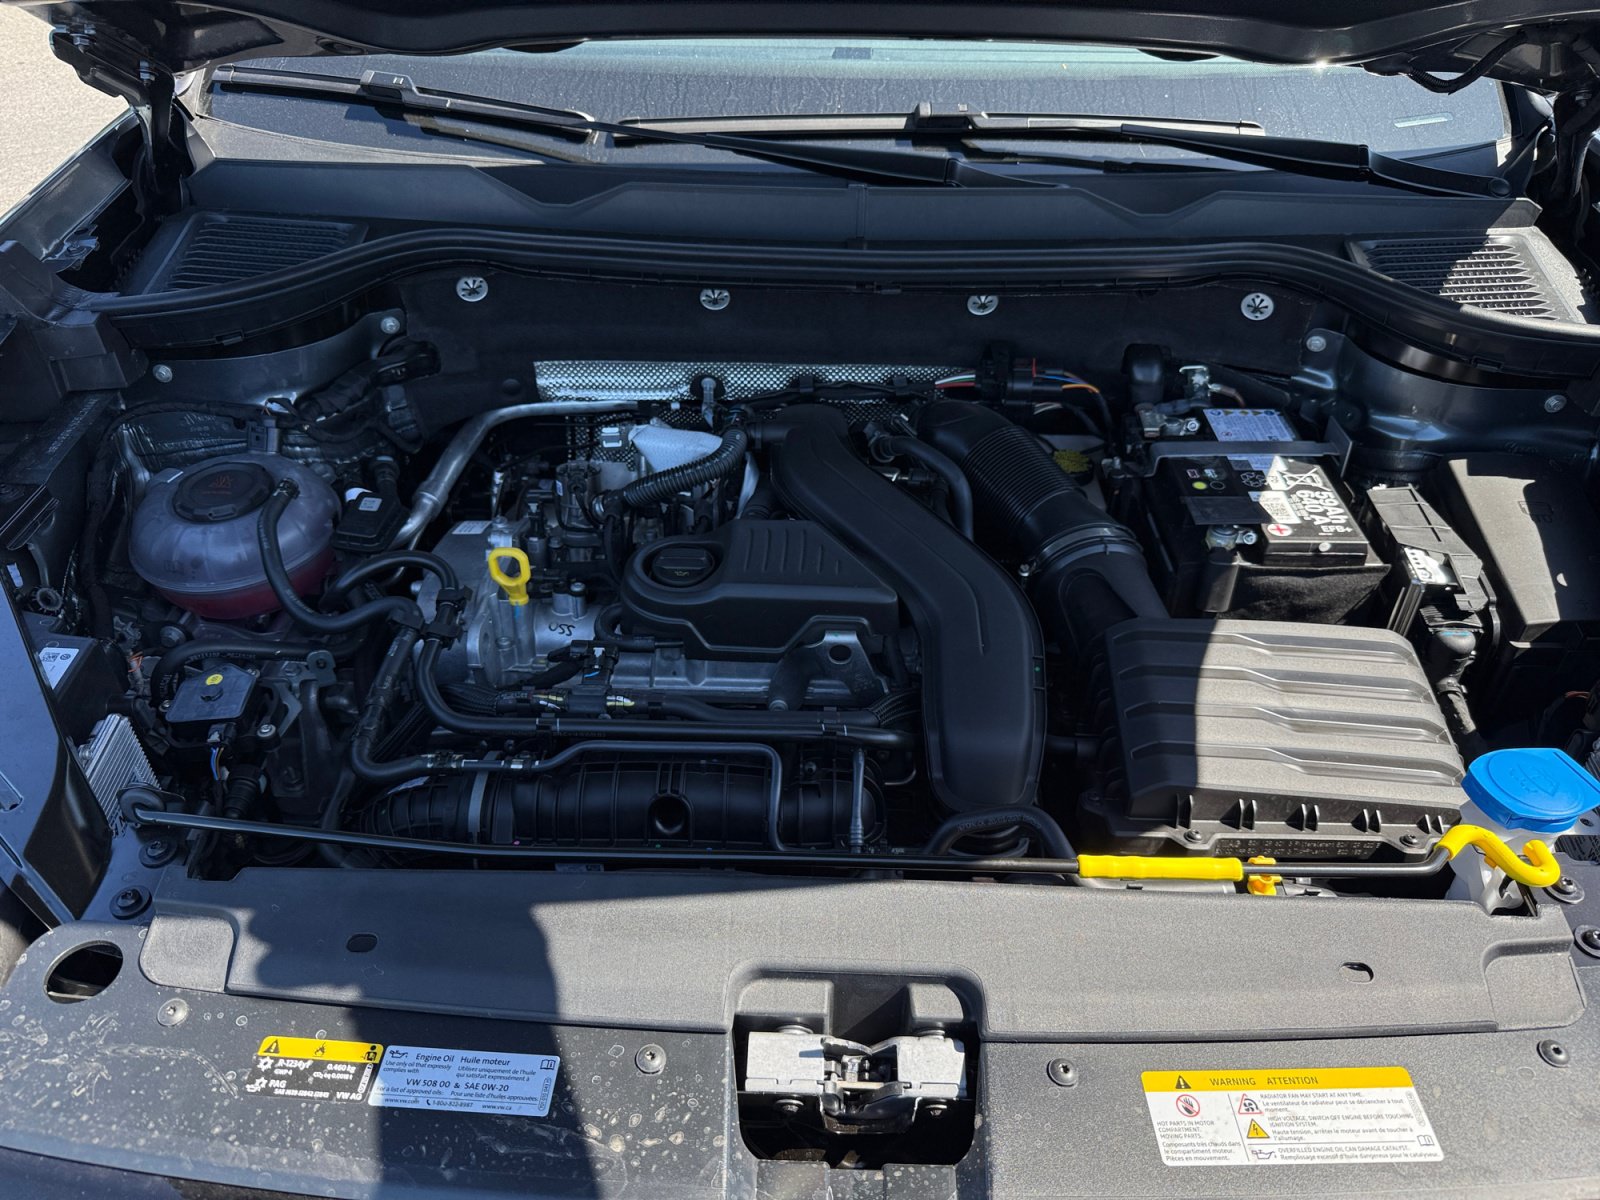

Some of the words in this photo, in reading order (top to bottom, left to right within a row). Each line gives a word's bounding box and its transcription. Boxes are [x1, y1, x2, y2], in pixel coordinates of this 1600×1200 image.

[1295, 489, 1323, 513] 640
[1309, 514, 1331, 526] A
[1313, 490, 1349, 524] 59Ah
[1321, 525, 1353, 533] EFB+
[416, 1053, 442, 1062] Engine
[443, 1054, 455, 1062] Oil
[460, 1056, 481, 1064] Huile
[482, 1058, 511, 1066] moteur
[347, 1064, 356, 1074] kg
[269, 1080, 287, 1088] PAG
[406, 1078, 422, 1086] VW
[422, 1079, 438, 1088] 508
[439, 1080, 451, 1088] 00
[464, 1082, 481, 1090] SAE
[481, 1083, 510, 1092] 0W-20
[1209, 1078, 1256, 1086] WARNING
[1266, 1076, 1319, 1086] ATTENTION
[336, 1092, 350, 1100] VW
[350, 1092, 363, 1100] AG
[406, 1088, 432, 1096] approved
[1162, 1141, 1196, 1149] Composants
